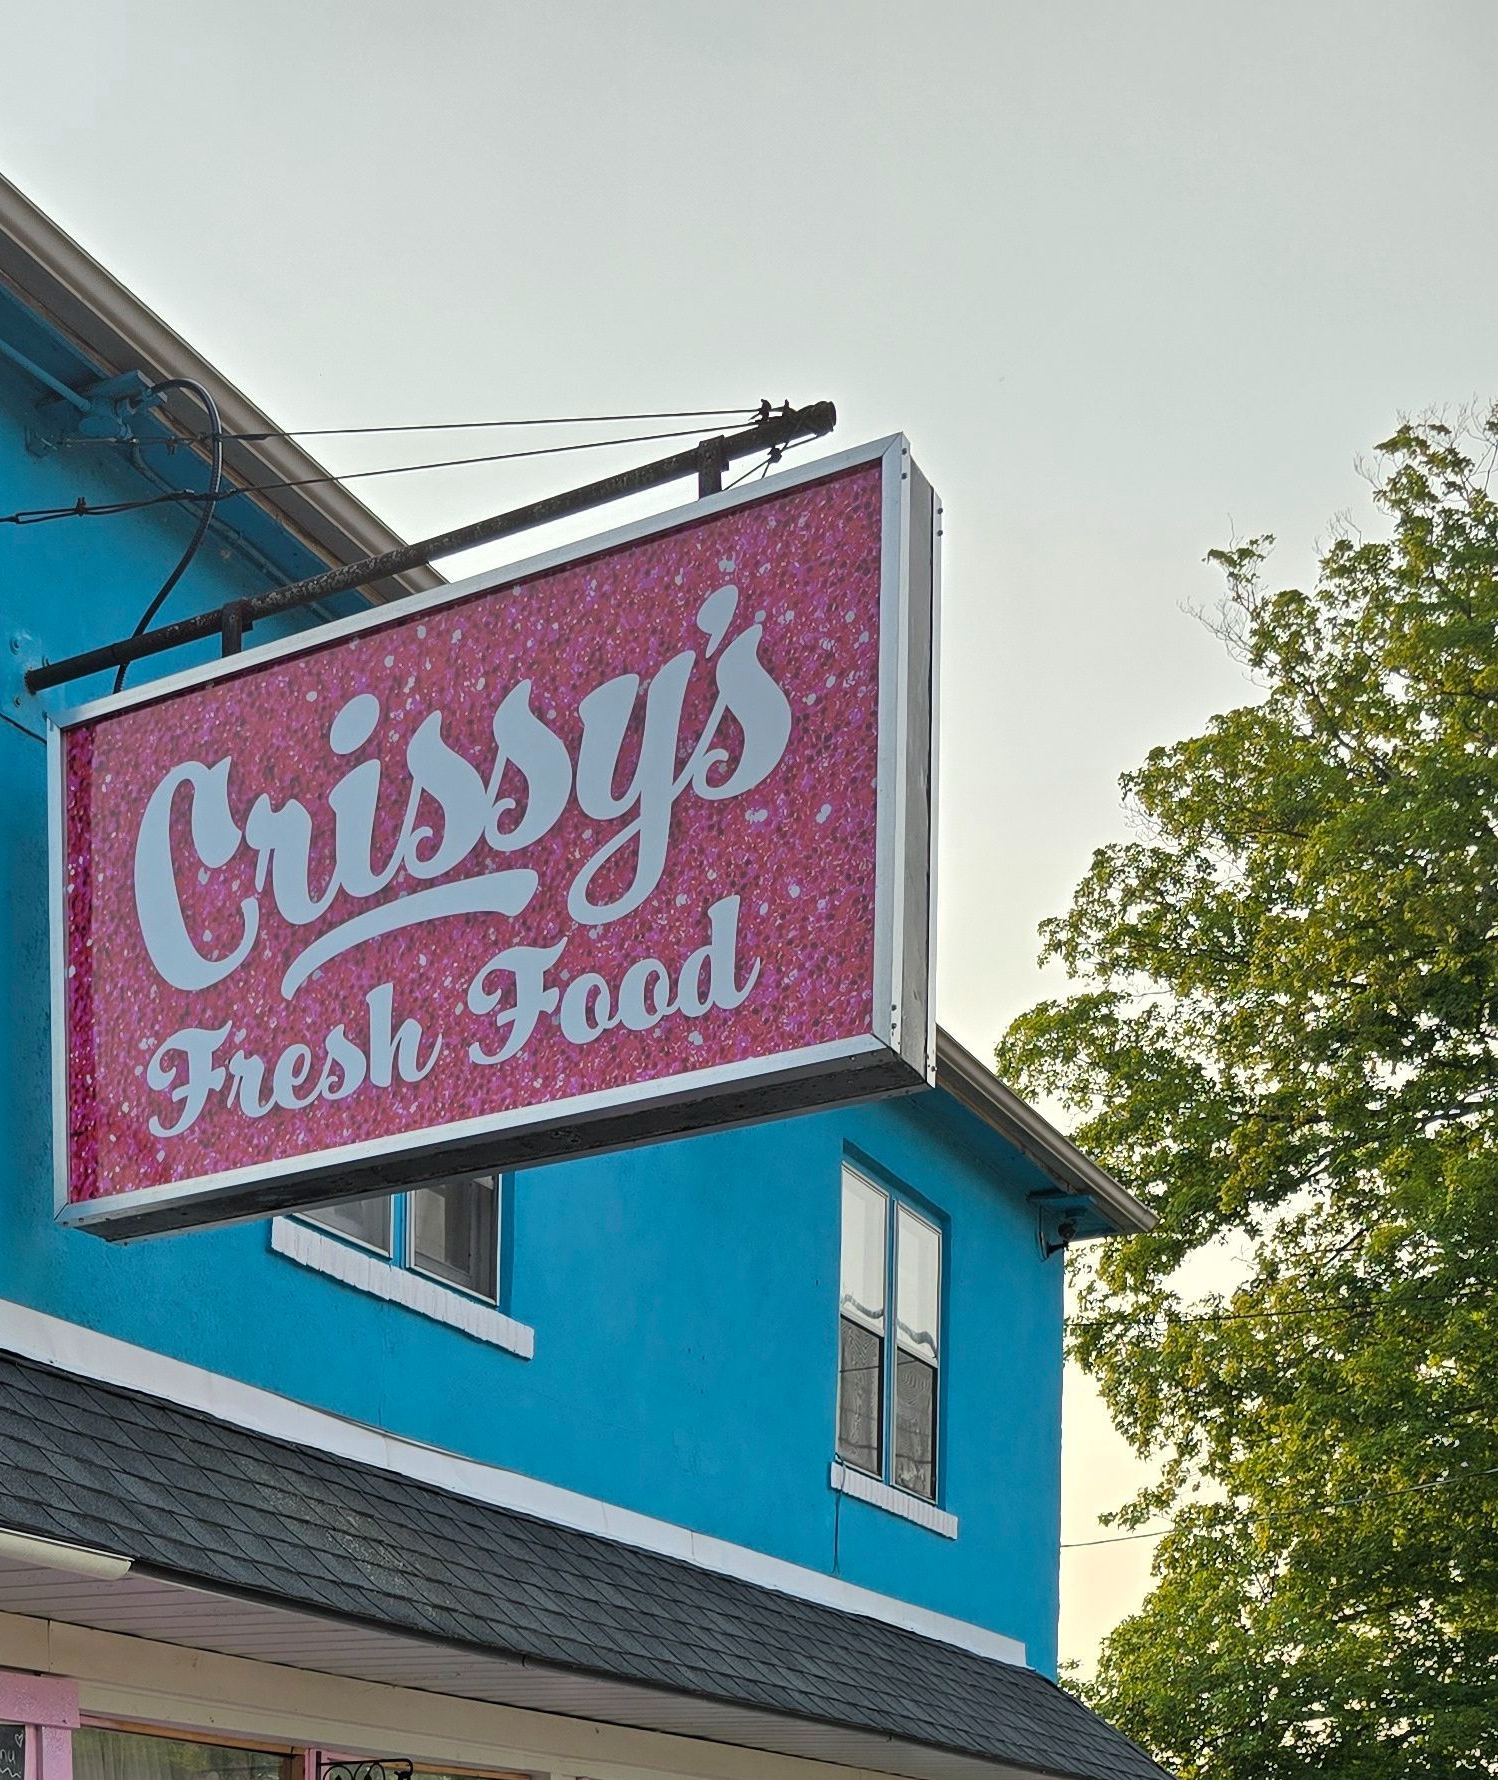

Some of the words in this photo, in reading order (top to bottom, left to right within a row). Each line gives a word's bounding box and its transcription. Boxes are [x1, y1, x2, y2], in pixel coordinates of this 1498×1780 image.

[133, 584, 793, 994] Crissy's
[146, 983, 443, 1138] Fresh
[467, 894, 762, 1067] Food
